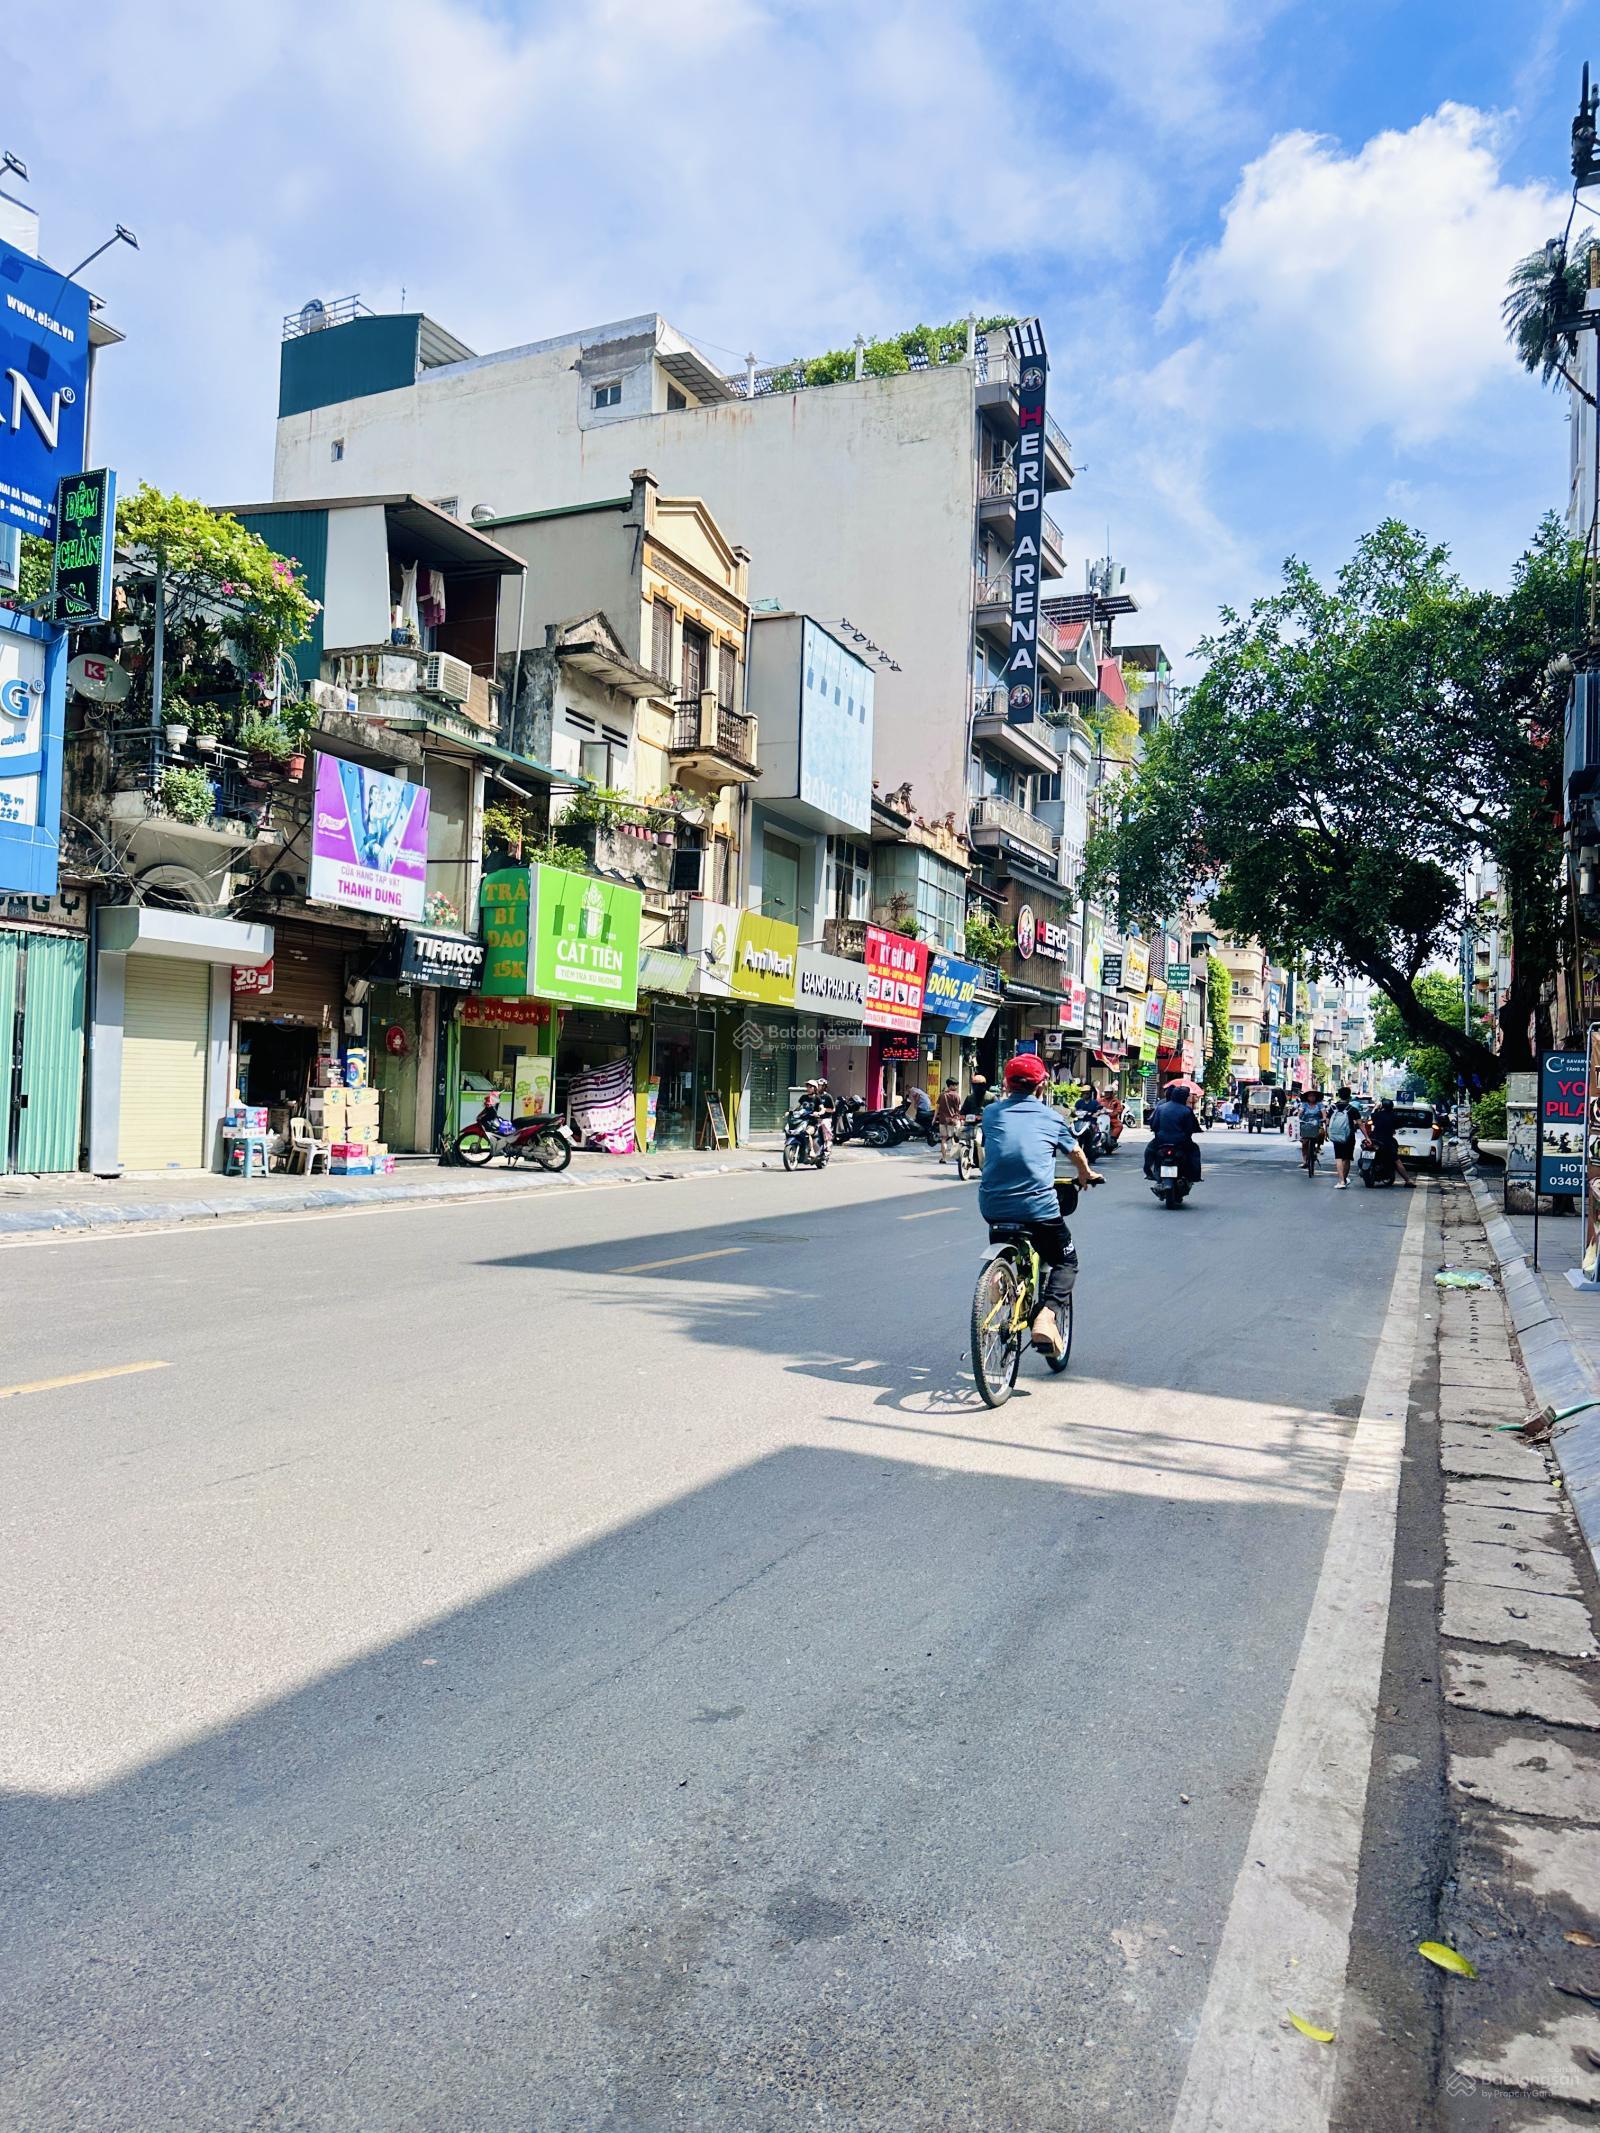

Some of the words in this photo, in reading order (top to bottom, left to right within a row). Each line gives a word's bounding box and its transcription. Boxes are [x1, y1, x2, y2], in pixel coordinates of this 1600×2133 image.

[6, 293, 75, 343] www.elan.vn
[1018, 406, 1042, 512] HERO
[65, 481, 99, 527] ĐỆM
[60, 528, 101, 570] CHĂN
[1010, 535, 1038, 672] ARENA
[338, 880, 372, 901] THANH
[485, 879, 528, 902] TRÀ
[494, 902, 516, 925] BÍ
[1036, 918, 1068, 950] HERO
[415, 935, 484, 965] TIFAROS
[557, 938, 588, 965] CÁT
[803, 971, 827, 995] BANG
